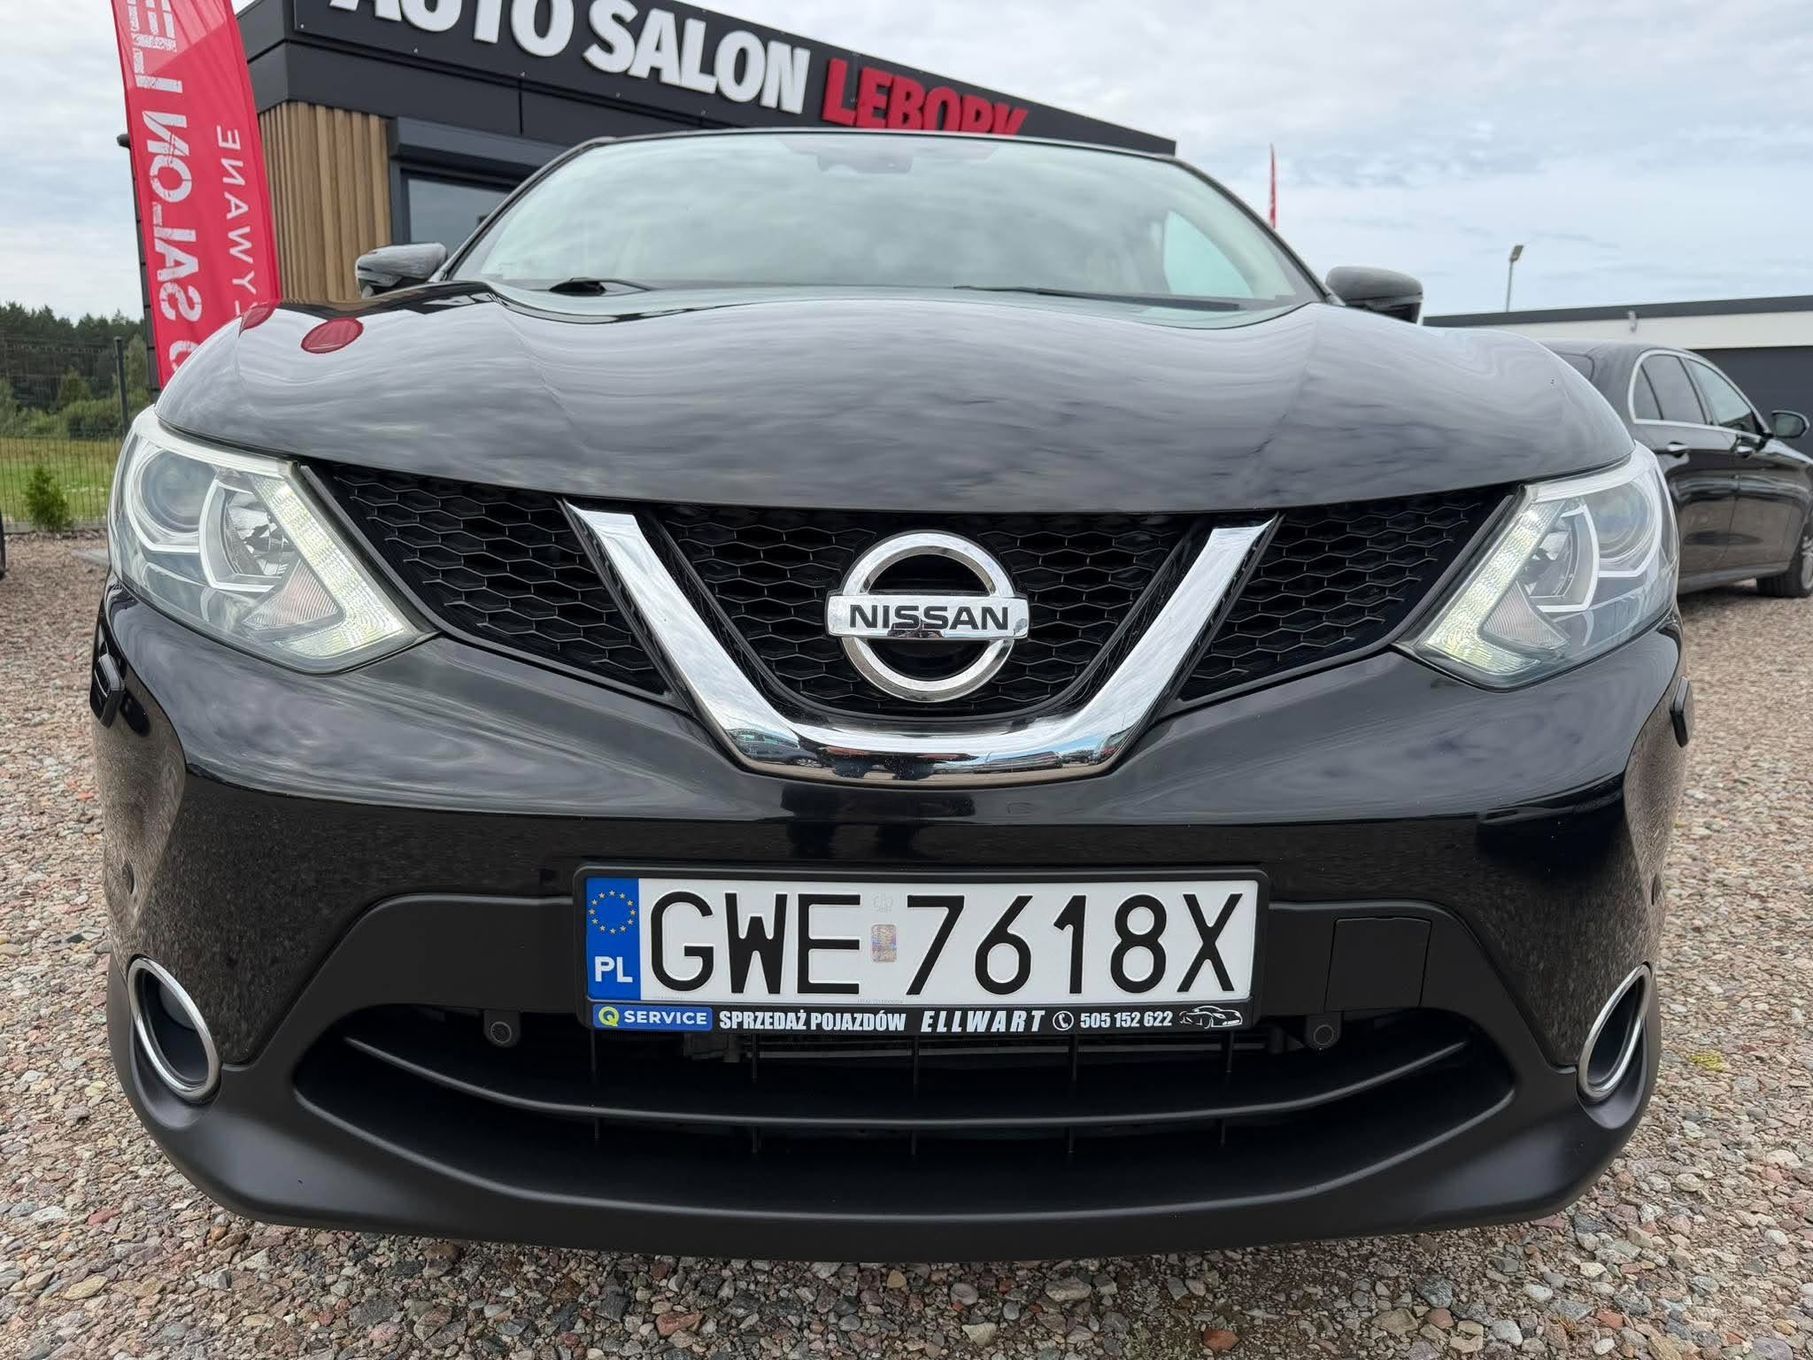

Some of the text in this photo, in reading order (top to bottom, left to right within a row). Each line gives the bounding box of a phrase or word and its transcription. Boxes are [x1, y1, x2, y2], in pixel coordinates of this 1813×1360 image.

[583, 0, 811, 114] SALON
[850, 604, 1019, 630] NISSAN
[651, 891, 1243, 995] GWE 7618X
[594, 956, 634, 983] PL
[624, 1010, 708, 1025] SERVICE
[719, 1009, 1173, 1032] SPRZEDAŻ POJAZDÓW ELLWART 505 152 622
